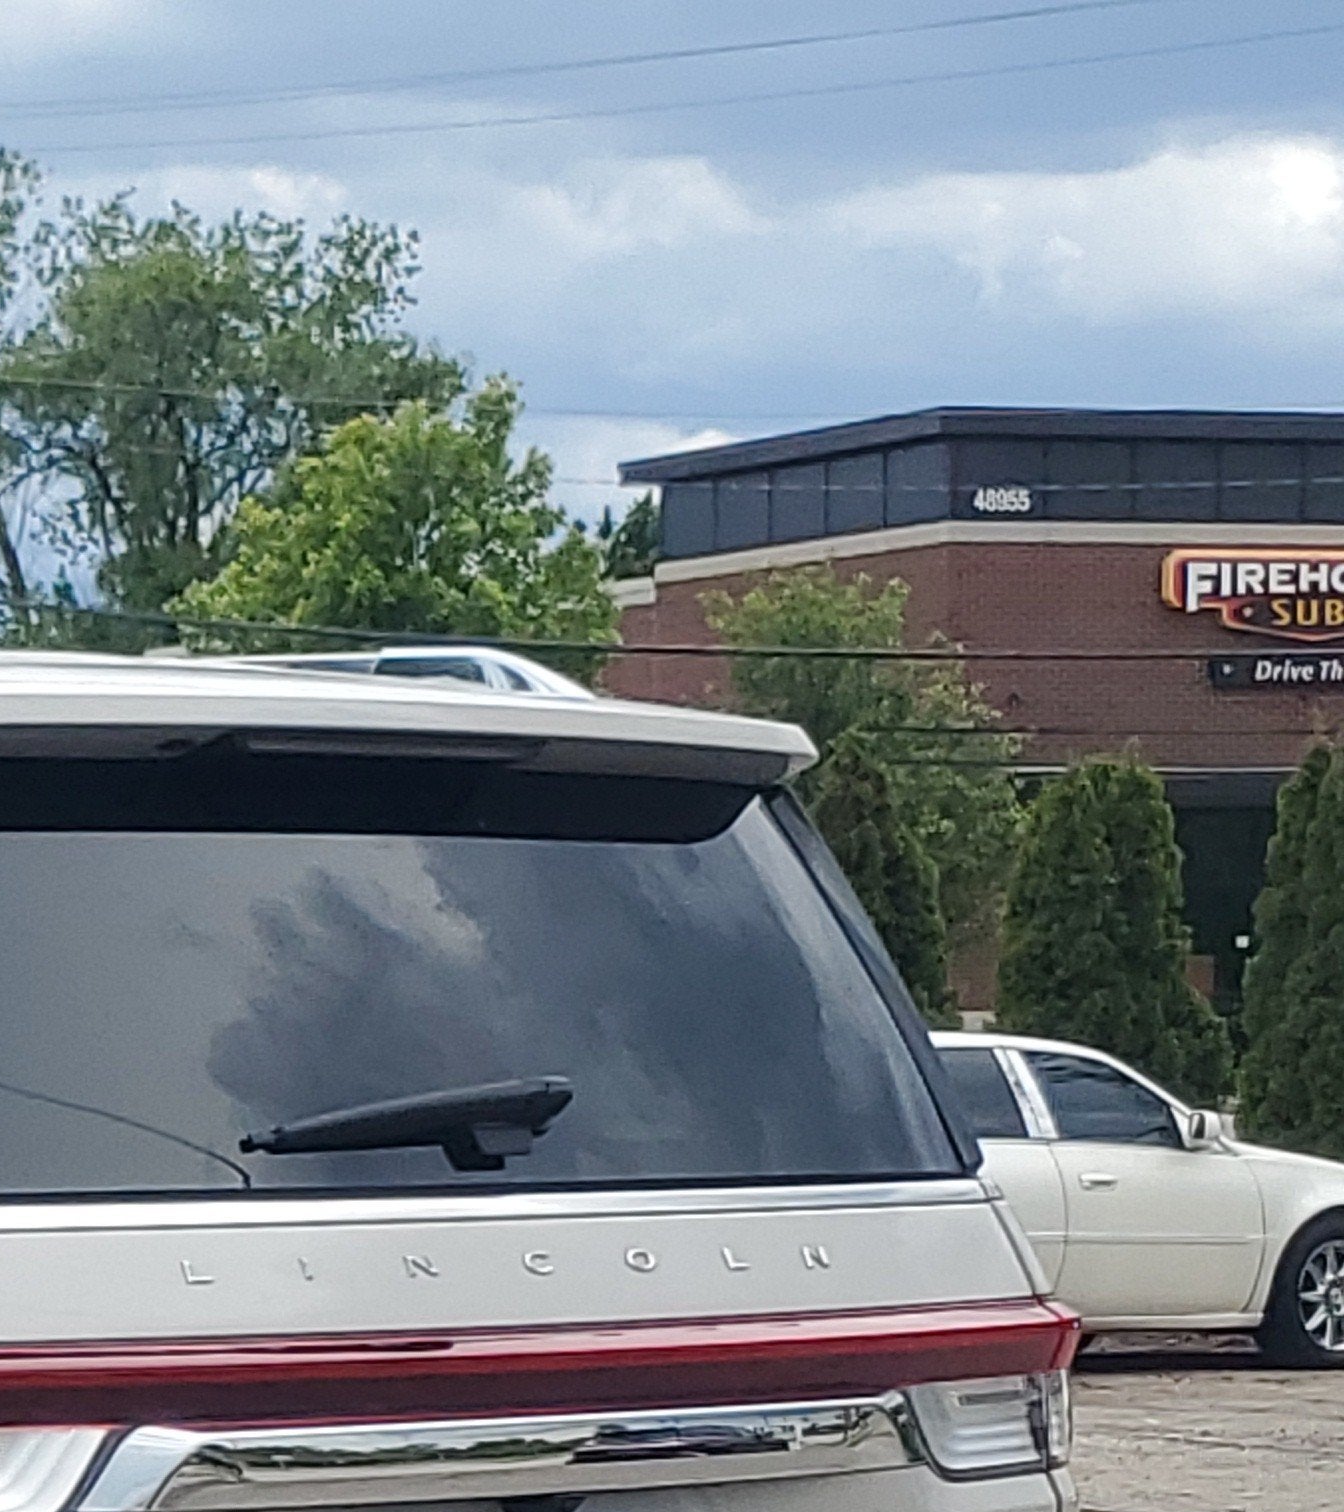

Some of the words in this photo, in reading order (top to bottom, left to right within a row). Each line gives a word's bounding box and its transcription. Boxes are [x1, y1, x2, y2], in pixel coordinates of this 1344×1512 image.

[973, 488, 1031, 512] 48955
[1270, 598, 1344, 626] SUB
[1255, 658, 1314, 682] Drive
[1319, 659, 1344, 682] Th
[179, 1243, 832, 1286] LINCOLN
